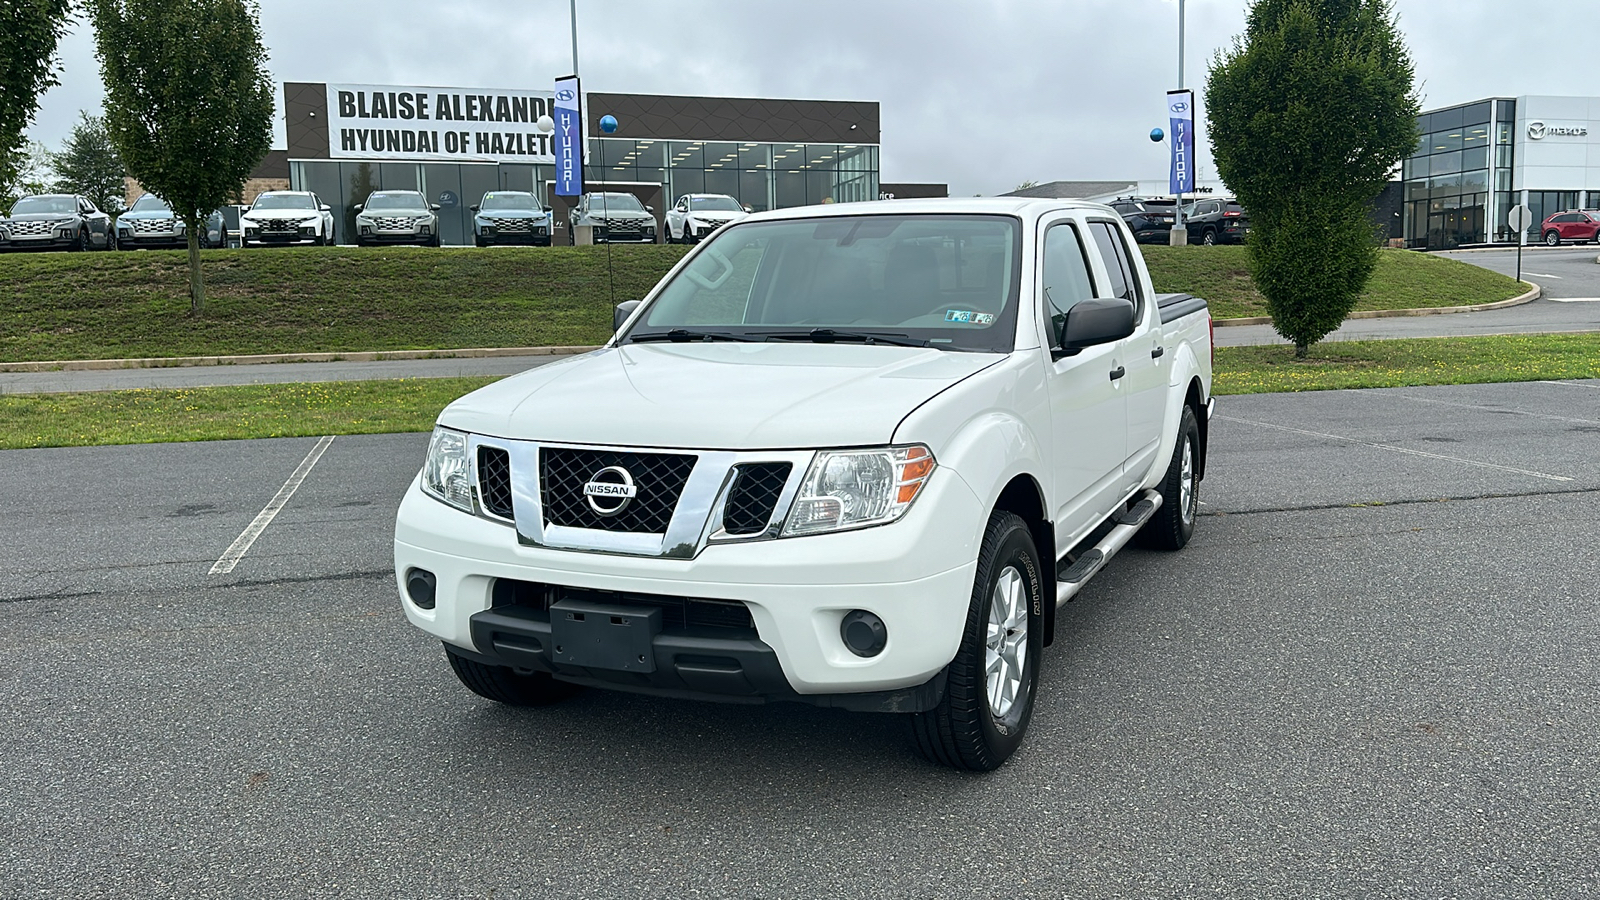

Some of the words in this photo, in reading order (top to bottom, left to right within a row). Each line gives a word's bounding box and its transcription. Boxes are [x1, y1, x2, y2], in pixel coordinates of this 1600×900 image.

[338, 91, 429, 120] BLAISE
[341, 128, 439, 153] HYUNDAI
[444, 131, 470, 154] OF
[561, 113, 572, 192] HYUNDAI
[1175, 123, 1185, 190] HYUNDAI
[586, 484, 629, 495] NISSAN
[1018, 551, 1040, 615] MICHELIN
